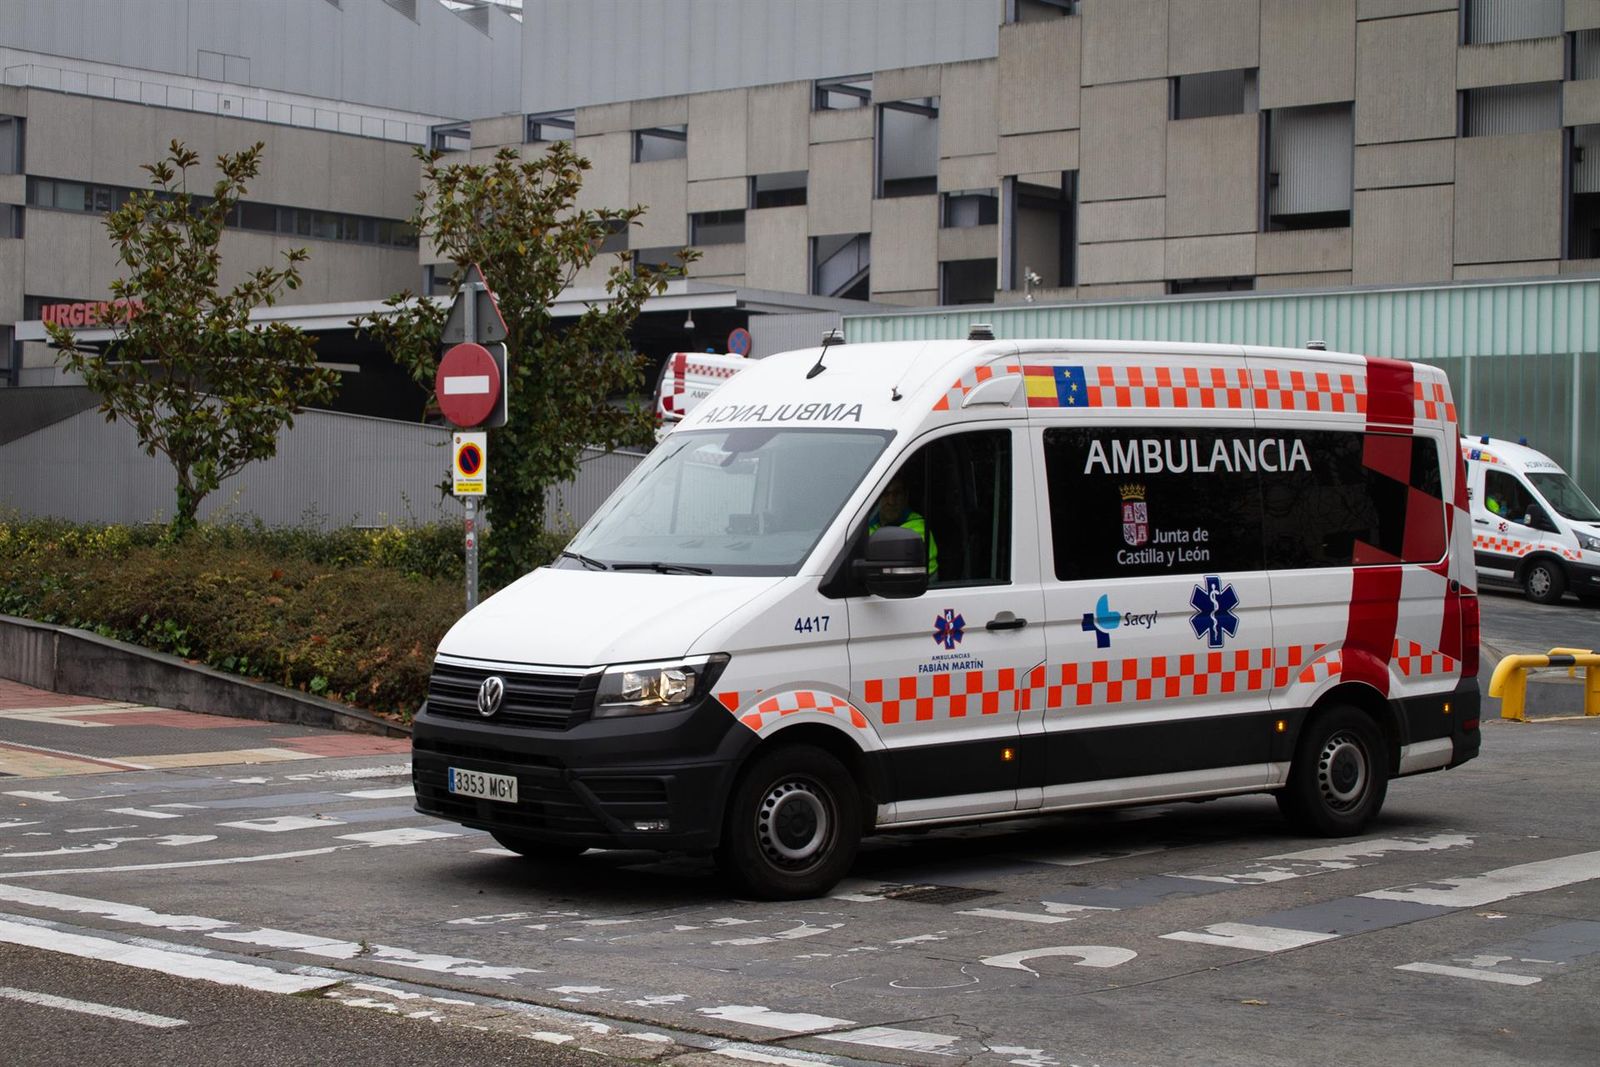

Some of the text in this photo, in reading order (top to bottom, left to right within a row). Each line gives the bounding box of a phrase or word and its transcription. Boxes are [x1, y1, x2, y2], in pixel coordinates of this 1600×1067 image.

[1083, 438, 1312, 475] AMBULANCIA
[1152, 527, 1209, 544] Junta de
[1117, 546, 1210, 567] Castilla y León
[794, 616, 830, 633] 4417
[1124, 610, 1158, 629] Sacyl
[918, 658, 984, 673] FABIÁN MARTÍN
[931, 652, 971, 661] AMBULANCIAS
[456, 772, 485, 794] 3353
[489, 777, 514, 799] MGY
